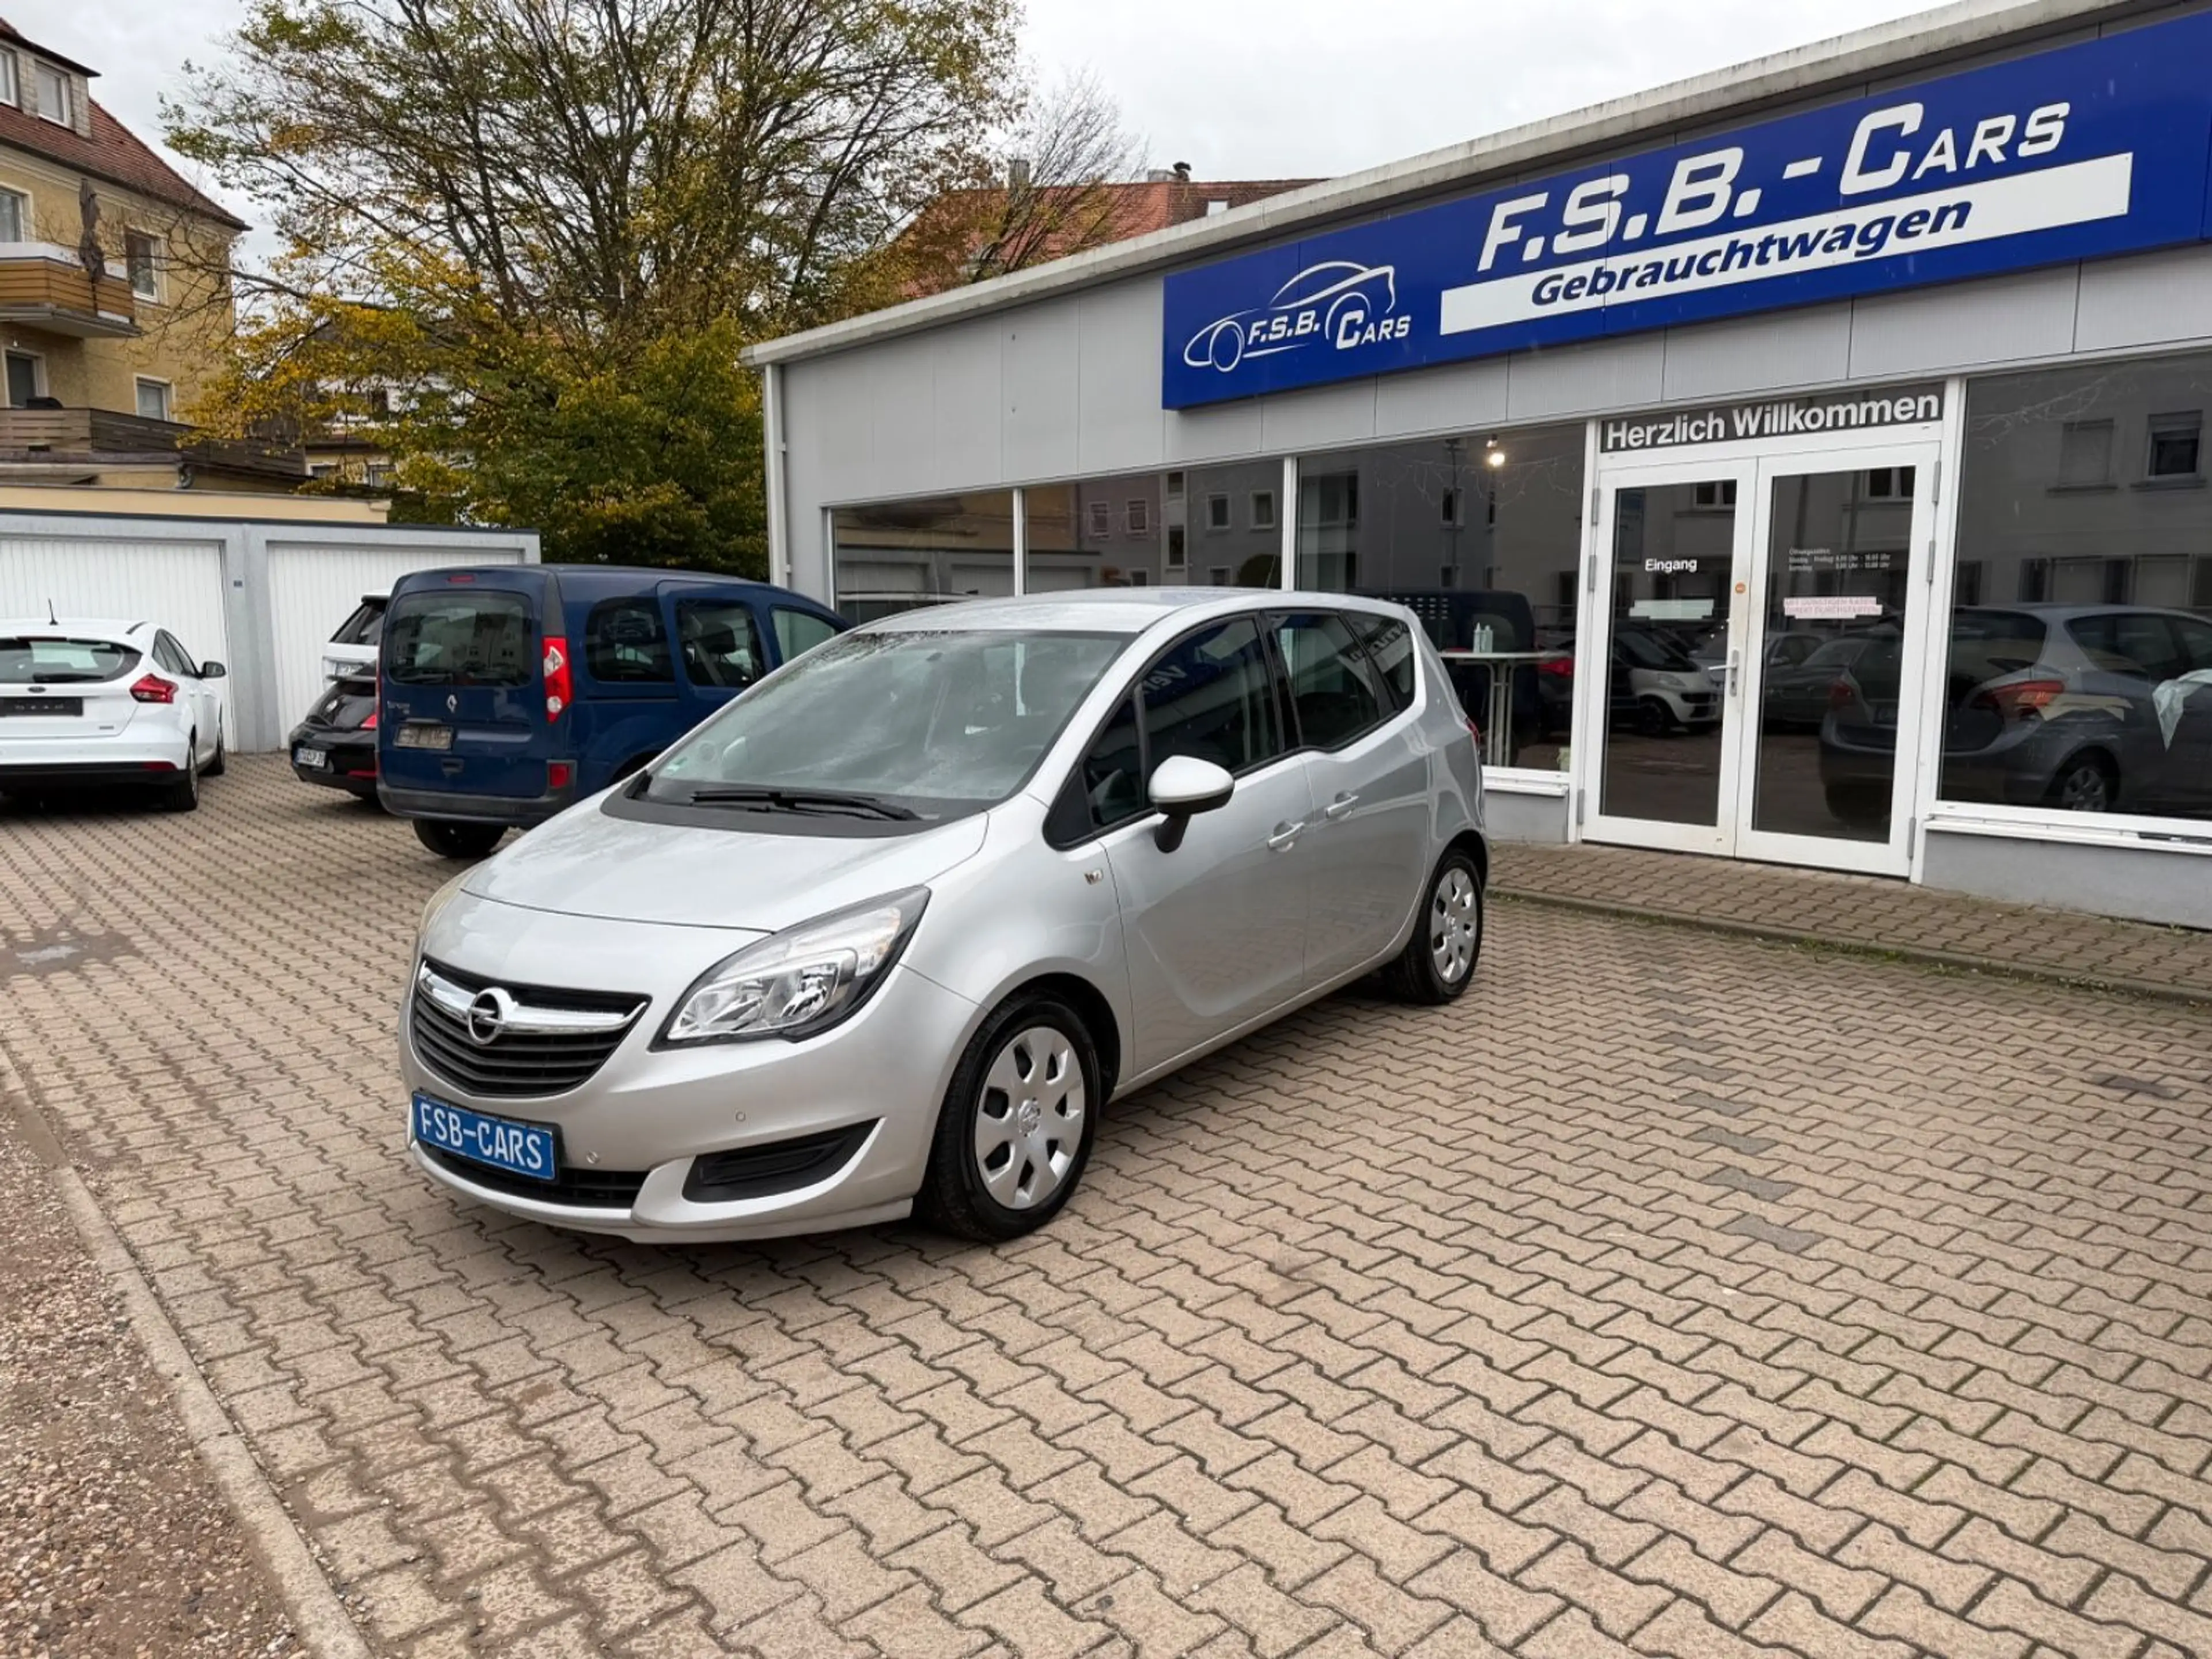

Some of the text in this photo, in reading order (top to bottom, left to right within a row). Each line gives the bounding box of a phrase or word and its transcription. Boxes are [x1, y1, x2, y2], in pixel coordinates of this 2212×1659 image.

[1476, 146, 1762, 272] F.S.B.
[1531, 200, 1973, 306] Gebrauchtwagen
[1247, 310, 1320, 345] F.S.B.
[1607, 395, 1939, 449] Herzlich Willkommen
[1645, 558, 1698, 573] Eingang
[419, 1103, 543, 1169] FSB-CARS
